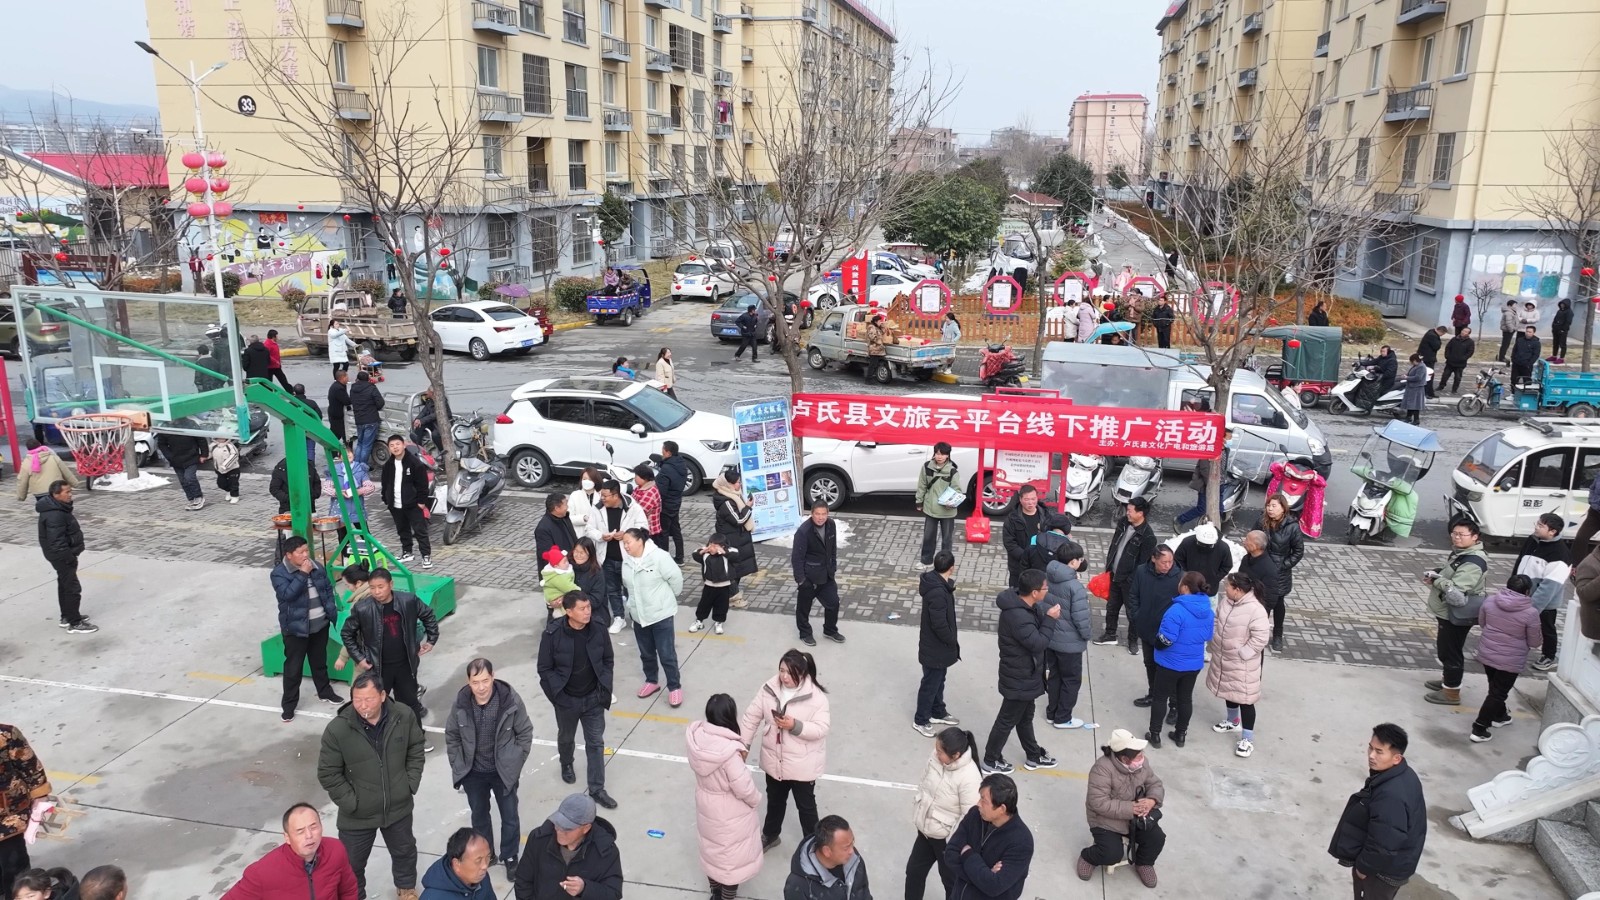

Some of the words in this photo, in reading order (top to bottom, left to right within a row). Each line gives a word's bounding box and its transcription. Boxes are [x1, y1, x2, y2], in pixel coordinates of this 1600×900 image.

[791, 399, 1218, 444] 卢氏县文旅云平台线下推广活动
